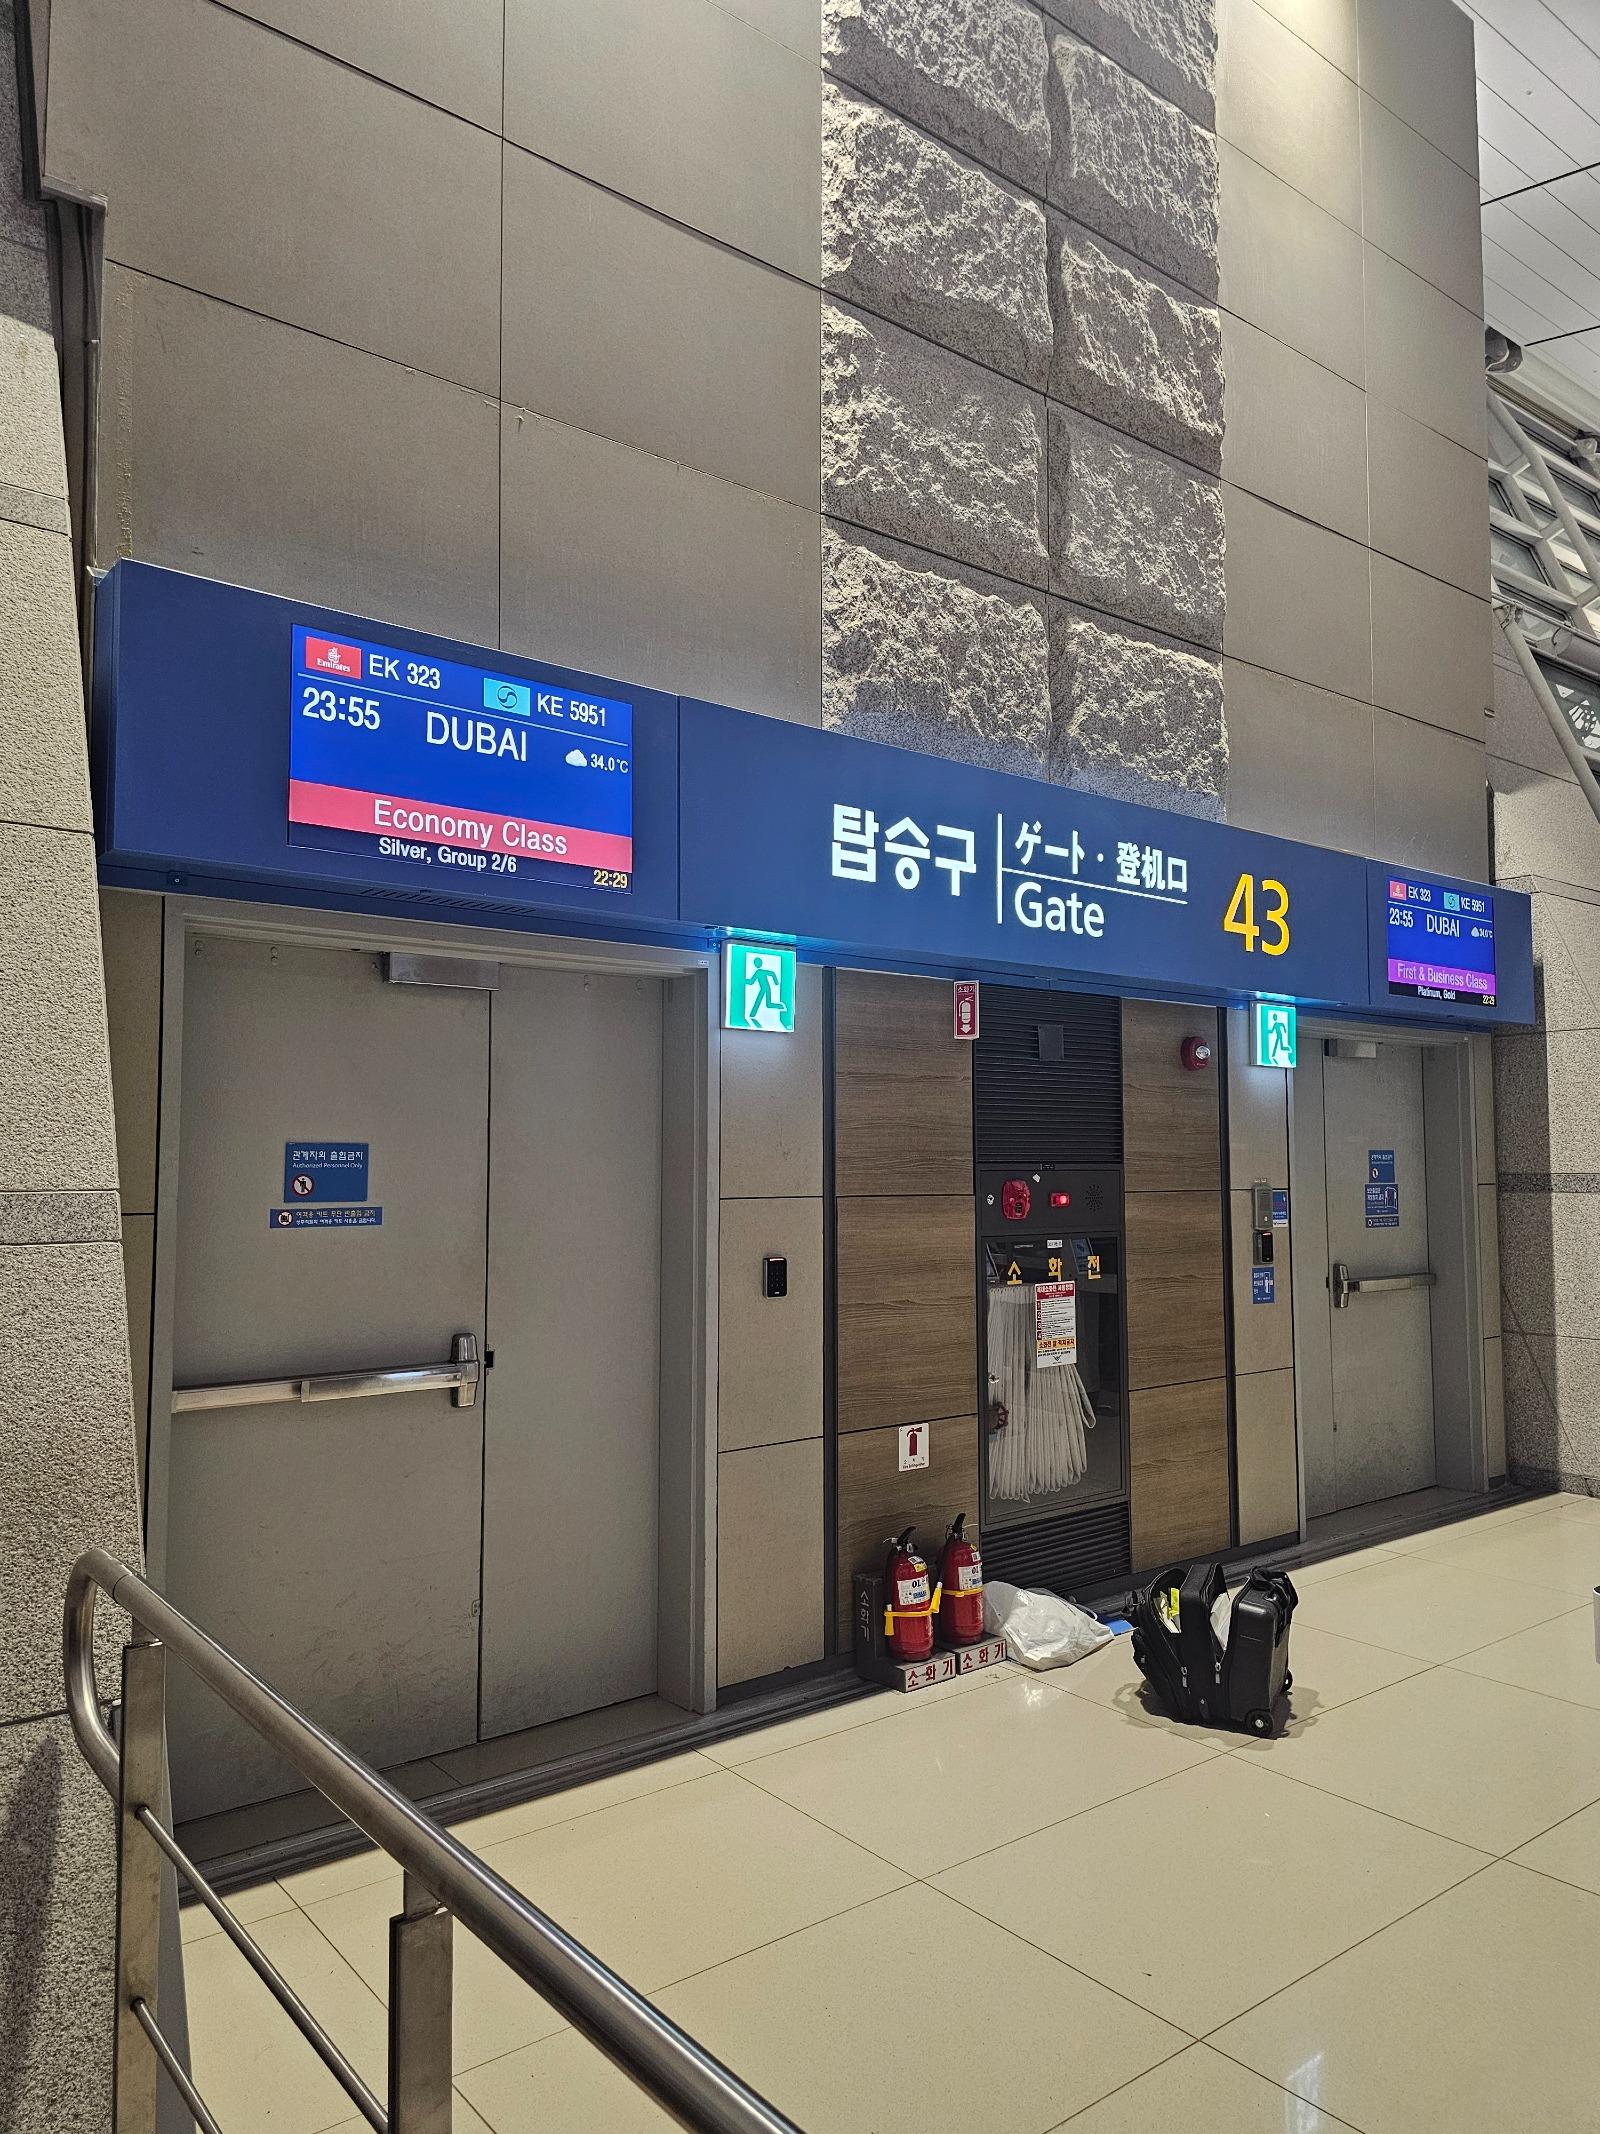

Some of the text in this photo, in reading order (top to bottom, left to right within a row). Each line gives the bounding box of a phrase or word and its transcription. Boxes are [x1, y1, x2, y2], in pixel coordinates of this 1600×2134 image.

[317, 658, 351, 673] Emirates
[369, 653, 441, 690] EK 323
[302, 686, 381, 730] 23:55
[537, 692, 606, 727] KE 5951
[426, 711, 527, 762] DUBAI
[374, 799, 568, 855] Economy Class
[379, 837, 517, 873] Silver, Group 2/6
[831, 803, 977, 897] 탑승구
[593, 869, 628, 889] 22:29
[1408, 886, 1419, 900] EK
[1419, 888, 1431, 903] 323
[1460, 897, 1485, 913] KE 5951
[1014, 881, 1105, 938] Gate
[1223, 873, 1291, 957] 43
[1389, 907, 1414, 928] 23:55
[1426, 913, 1460, 938] DUBAI
[1397, 963, 1488, 991] First & Business Class
[1443, 989, 1456, 1000] Gold
[292, 1150, 363, 1161] 관계자외 출입금지
[350, 1162, 363, 1170] Only
[963, 1642, 1004, 1671] 소화기
[908, 1658, 953, 1689] 소화기
